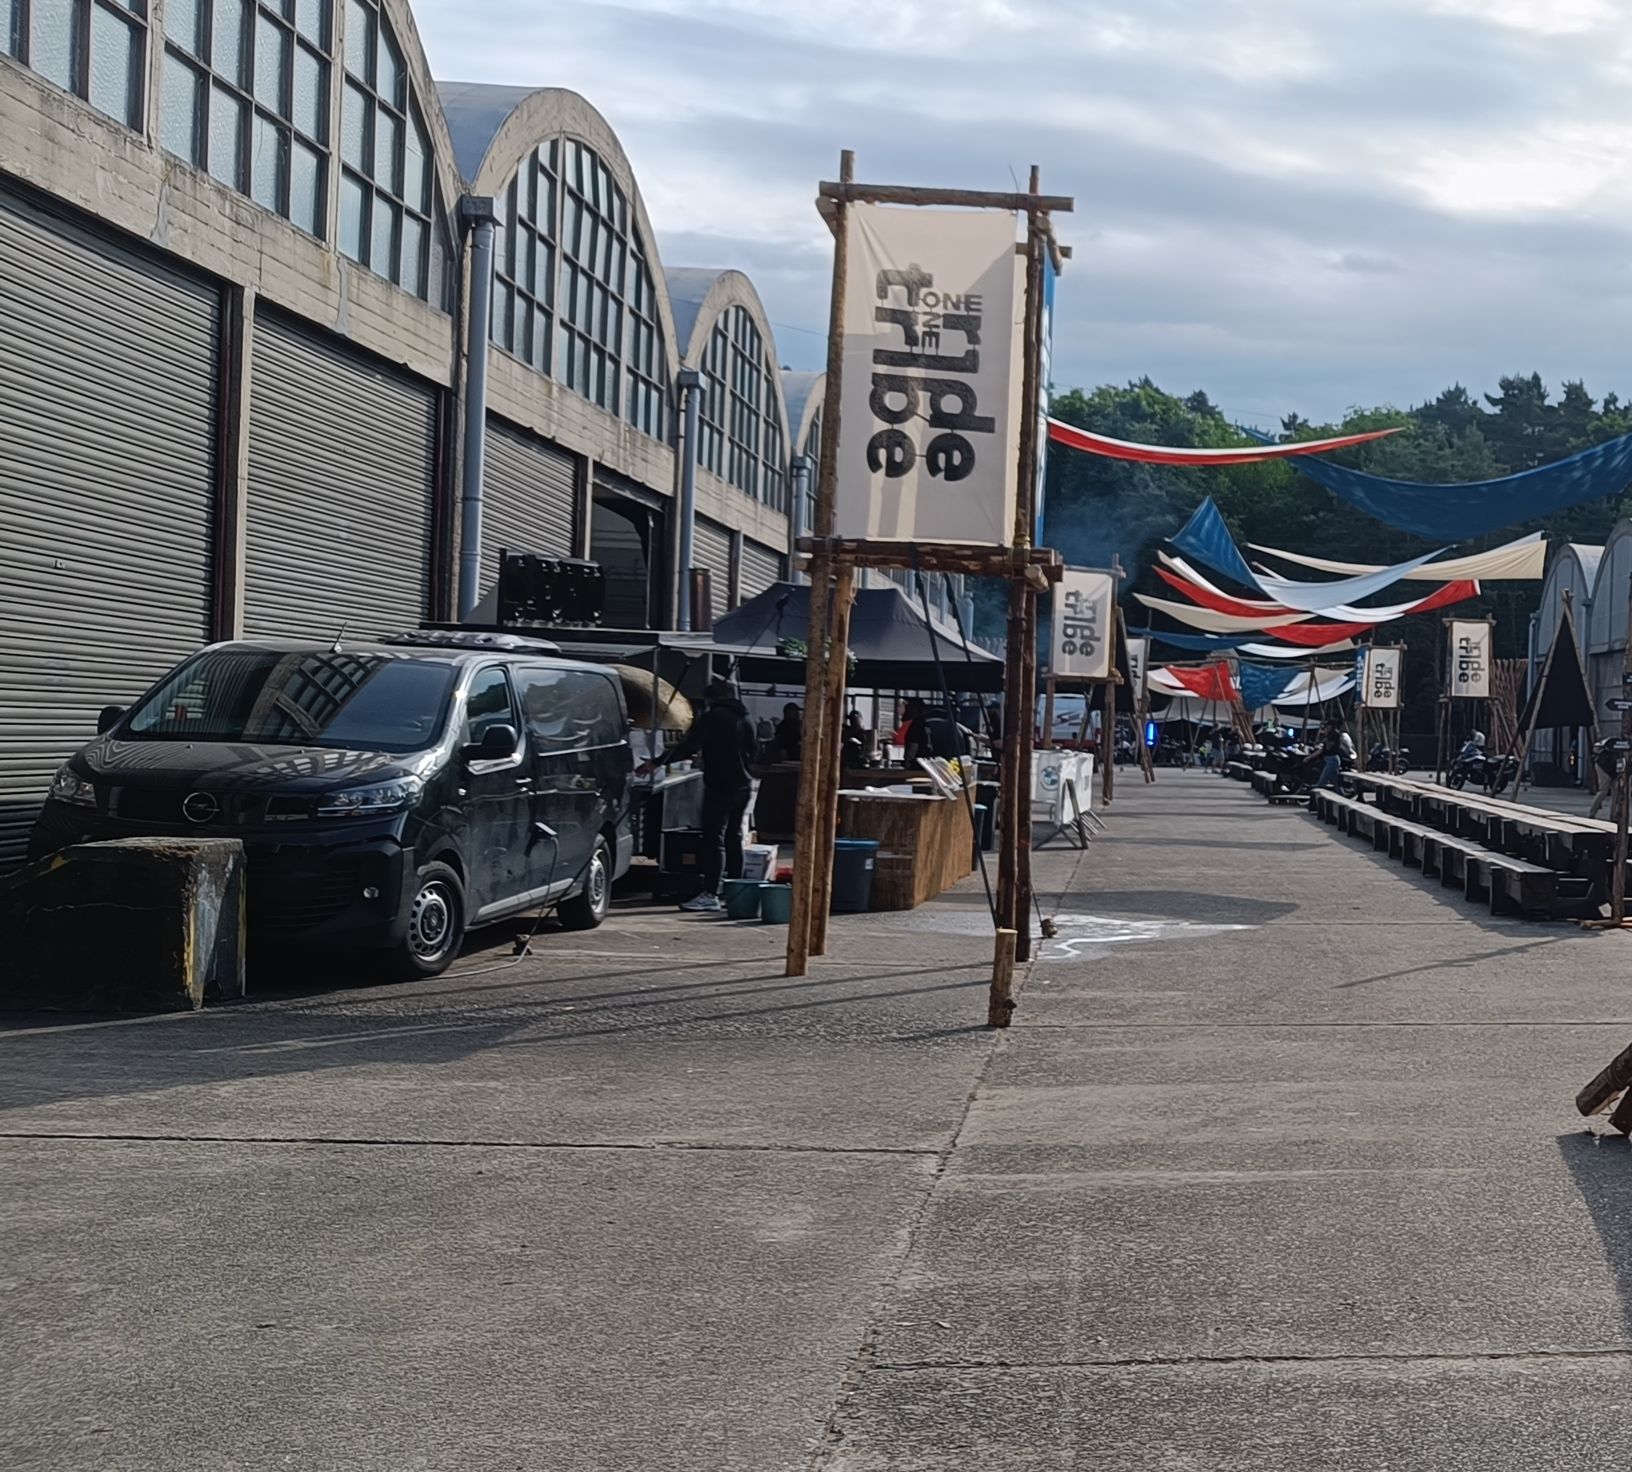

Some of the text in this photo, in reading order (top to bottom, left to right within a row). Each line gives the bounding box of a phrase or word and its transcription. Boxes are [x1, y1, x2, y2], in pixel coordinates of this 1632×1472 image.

[924, 290, 984, 312] ONE
[866, 263, 934, 478] tribe
[925, 313, 995, 482] ride
[1062, 590, 1083, 656] tribe
[1079, 601, 1101, 657] ride
[1374, 662, 1386, 698] tribe
[1458, 636, 1471, 683] tribe
